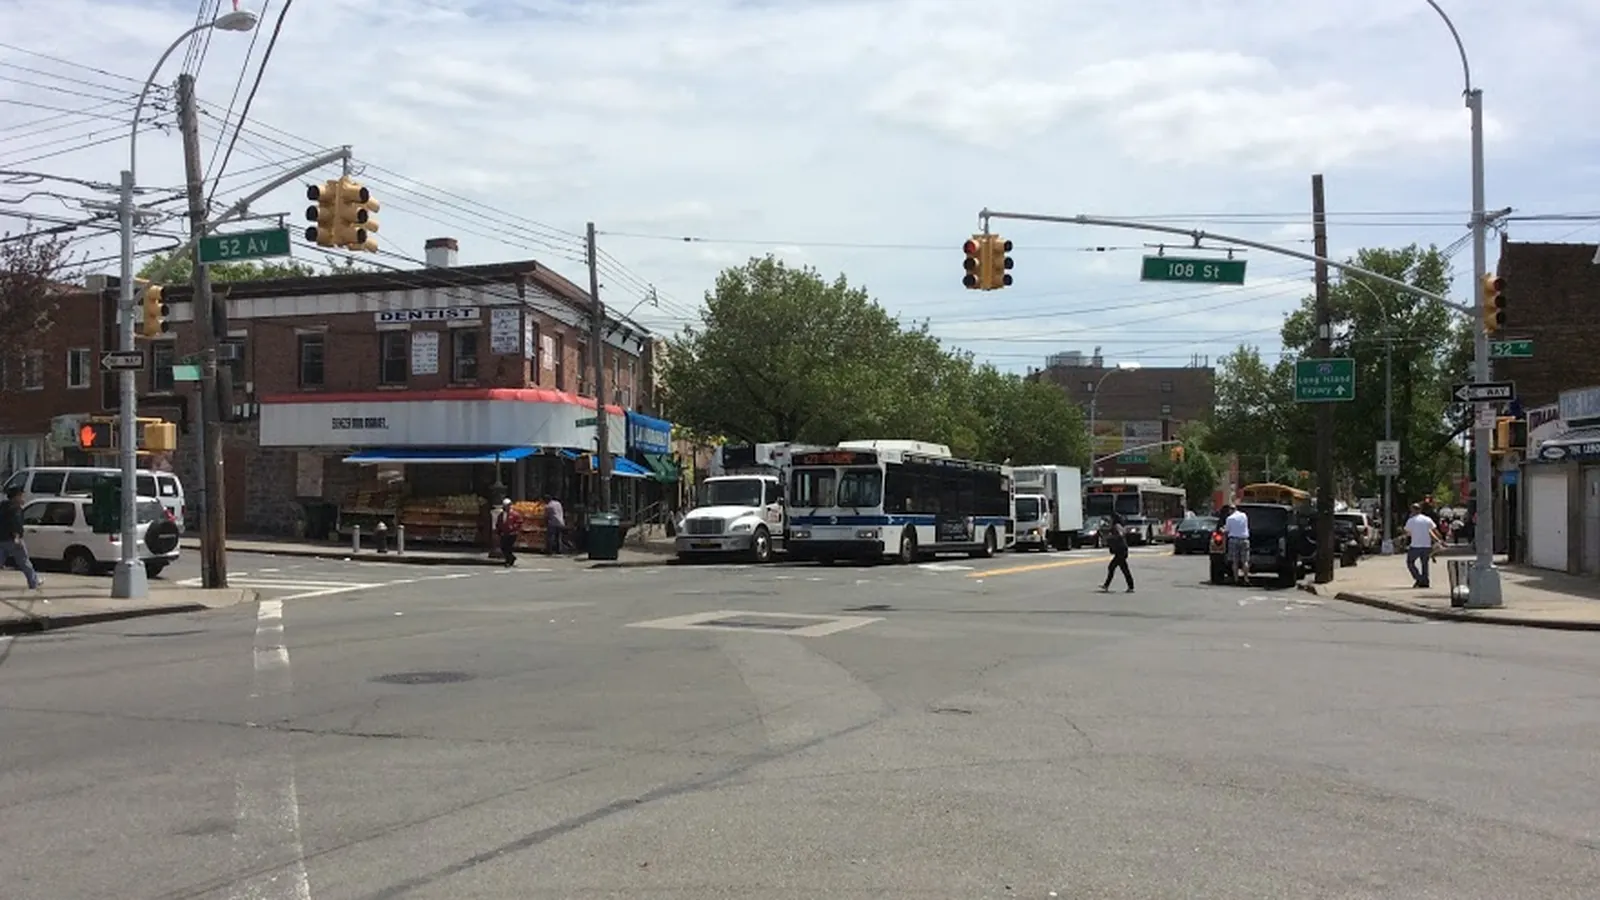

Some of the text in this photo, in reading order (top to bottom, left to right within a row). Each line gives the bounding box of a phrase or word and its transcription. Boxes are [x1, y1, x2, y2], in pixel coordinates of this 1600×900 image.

[219, 237, 269, 257] 52 Av
[1168, 263, 1220, 279] 108 St
[380, 308, 474, 321] DENTIST
[1494, 343, 1513, 356] 52
[1298, 375, 1351, 385] Long Island
[1486, 387, 1507, 397] WAY
[1379, 455, 1397, 465] 25
